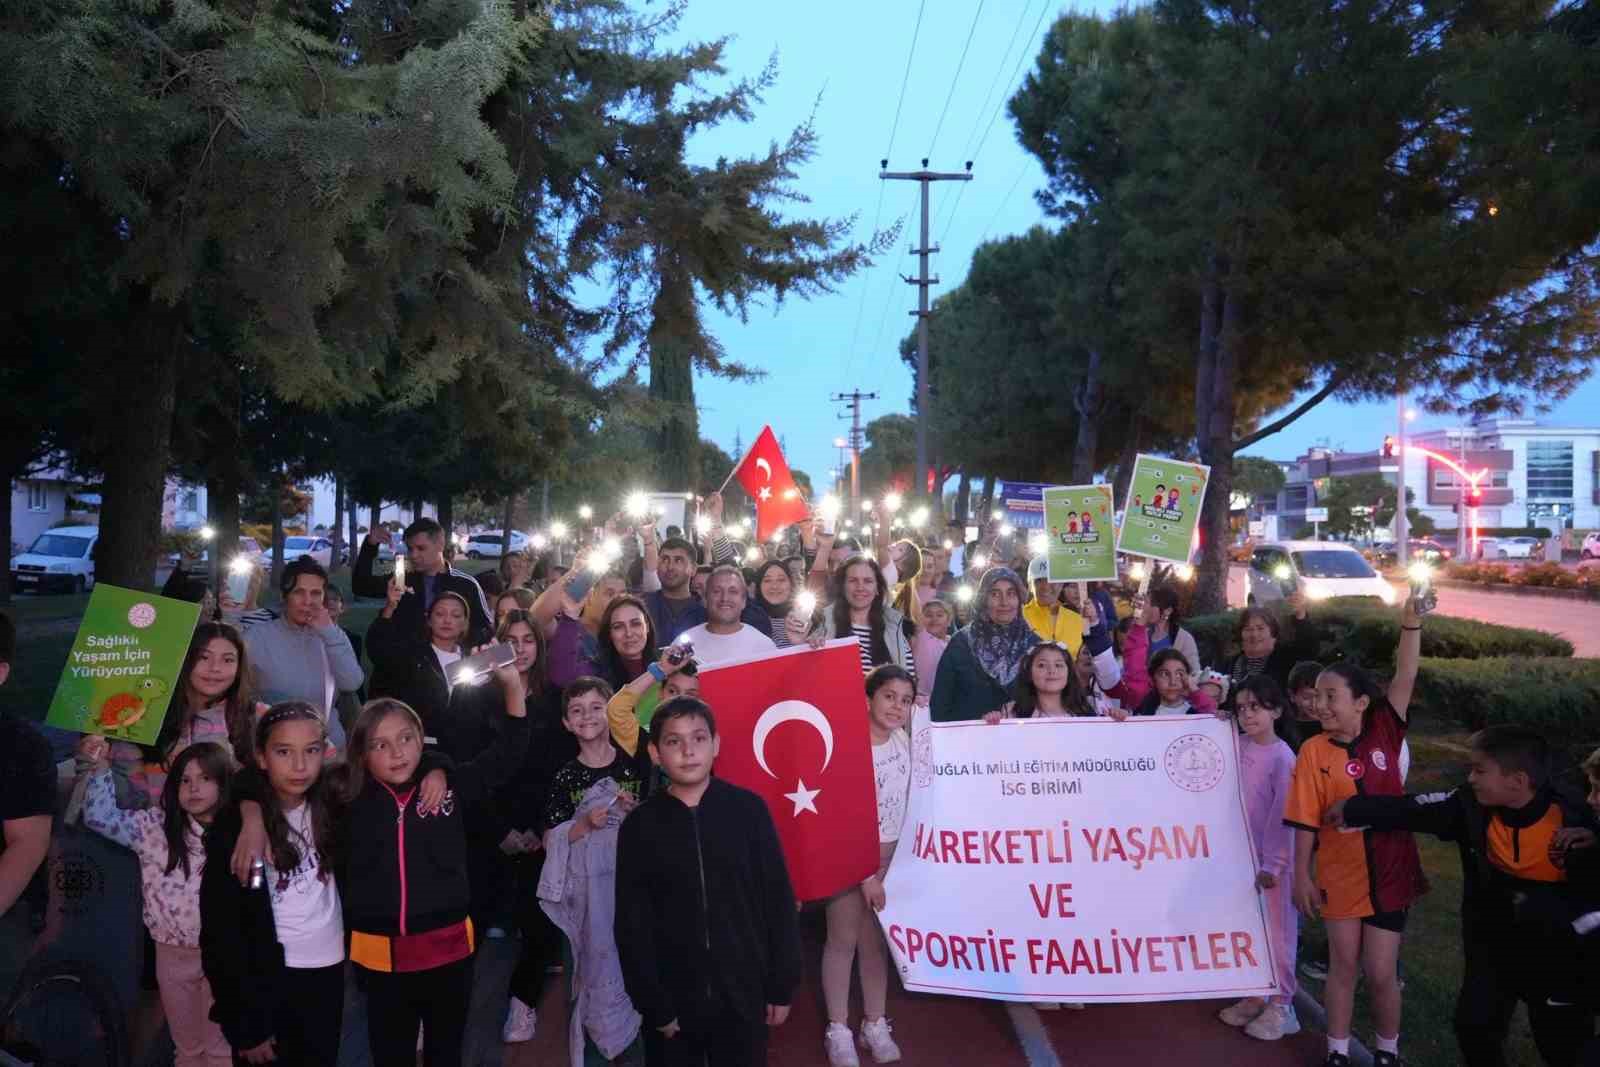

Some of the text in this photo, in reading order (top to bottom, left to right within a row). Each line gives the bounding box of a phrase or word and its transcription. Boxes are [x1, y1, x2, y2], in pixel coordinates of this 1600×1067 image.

[87, 634, 139, 648] Sağlıklı
[73, 647, 150, 663] Yaşam İçin
[71, 664, 150, 678] Yürüyoruz!
[932, 757, 1156, 776] UĞLA İL MİLLİ EĞİTİM MÜDÜRLÜĞÜ
[1001, 779, 1082, 796] İSG BİRİMİ
[912, 820, 1209, 870] HAREKETLİ YAŞAM
[1029, 884, 1075, 918] VE
[889, 924, 1258, 974] SPORTİF FAALİYETLER
